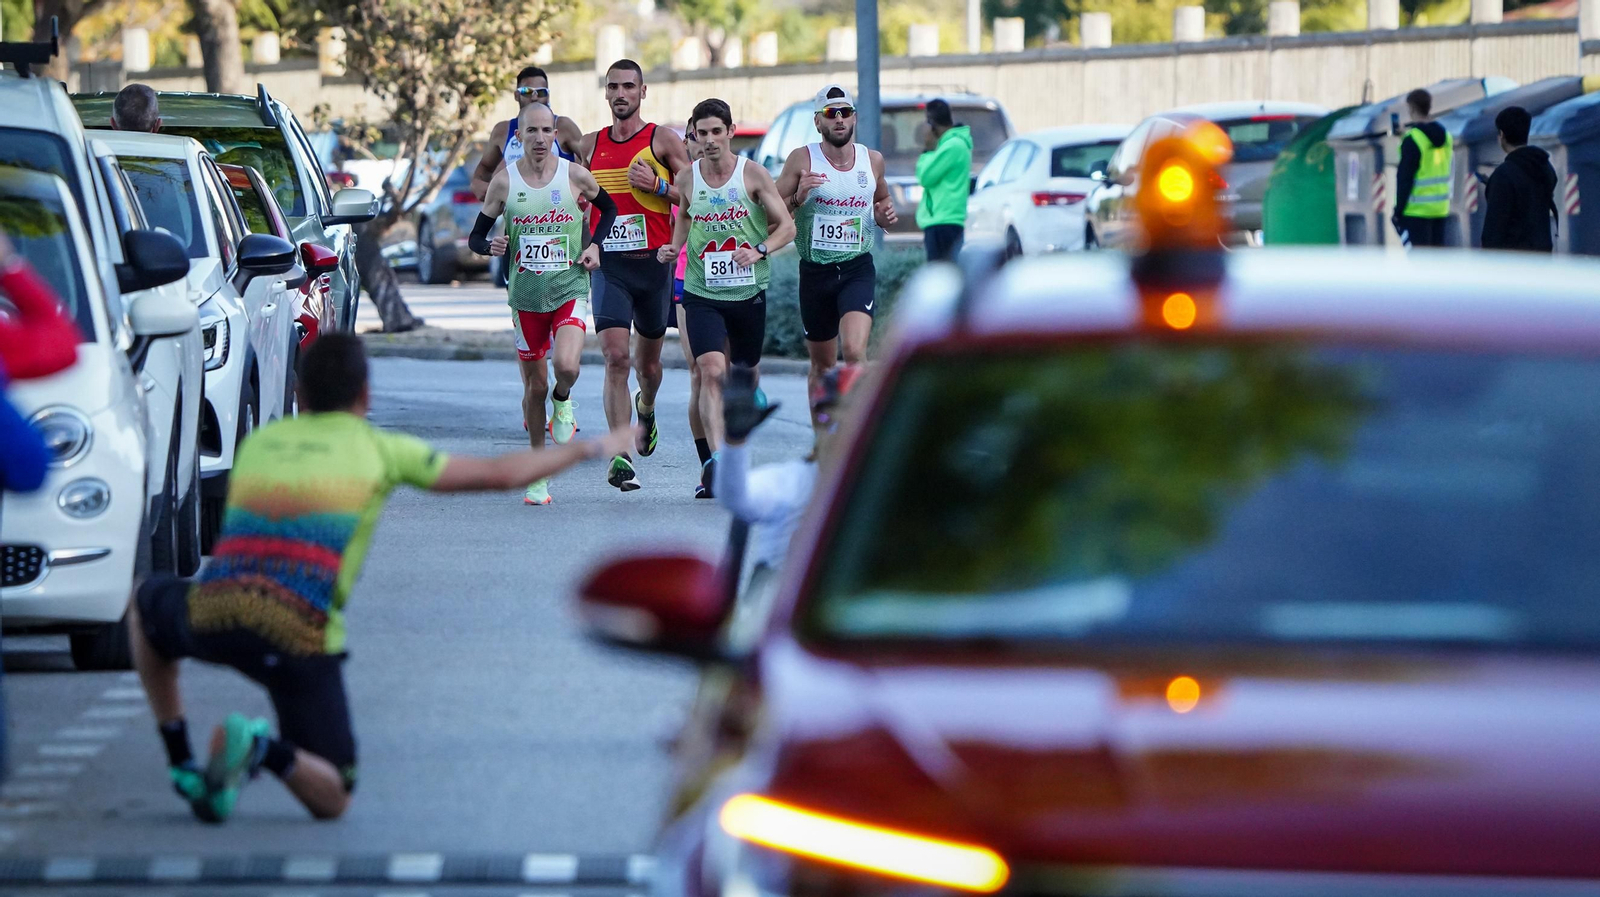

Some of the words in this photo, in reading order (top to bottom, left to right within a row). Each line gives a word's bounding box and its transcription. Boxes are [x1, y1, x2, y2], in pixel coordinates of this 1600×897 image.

[815, 196, 868, 208] maratón
[513, 208, 574, 224] maratón
[705, 222, 743, 232] JEREZ
[820, 224, 843, 239] 193
[526, 244, 550, 259] 270
[710, 260, 734, 275] 581
